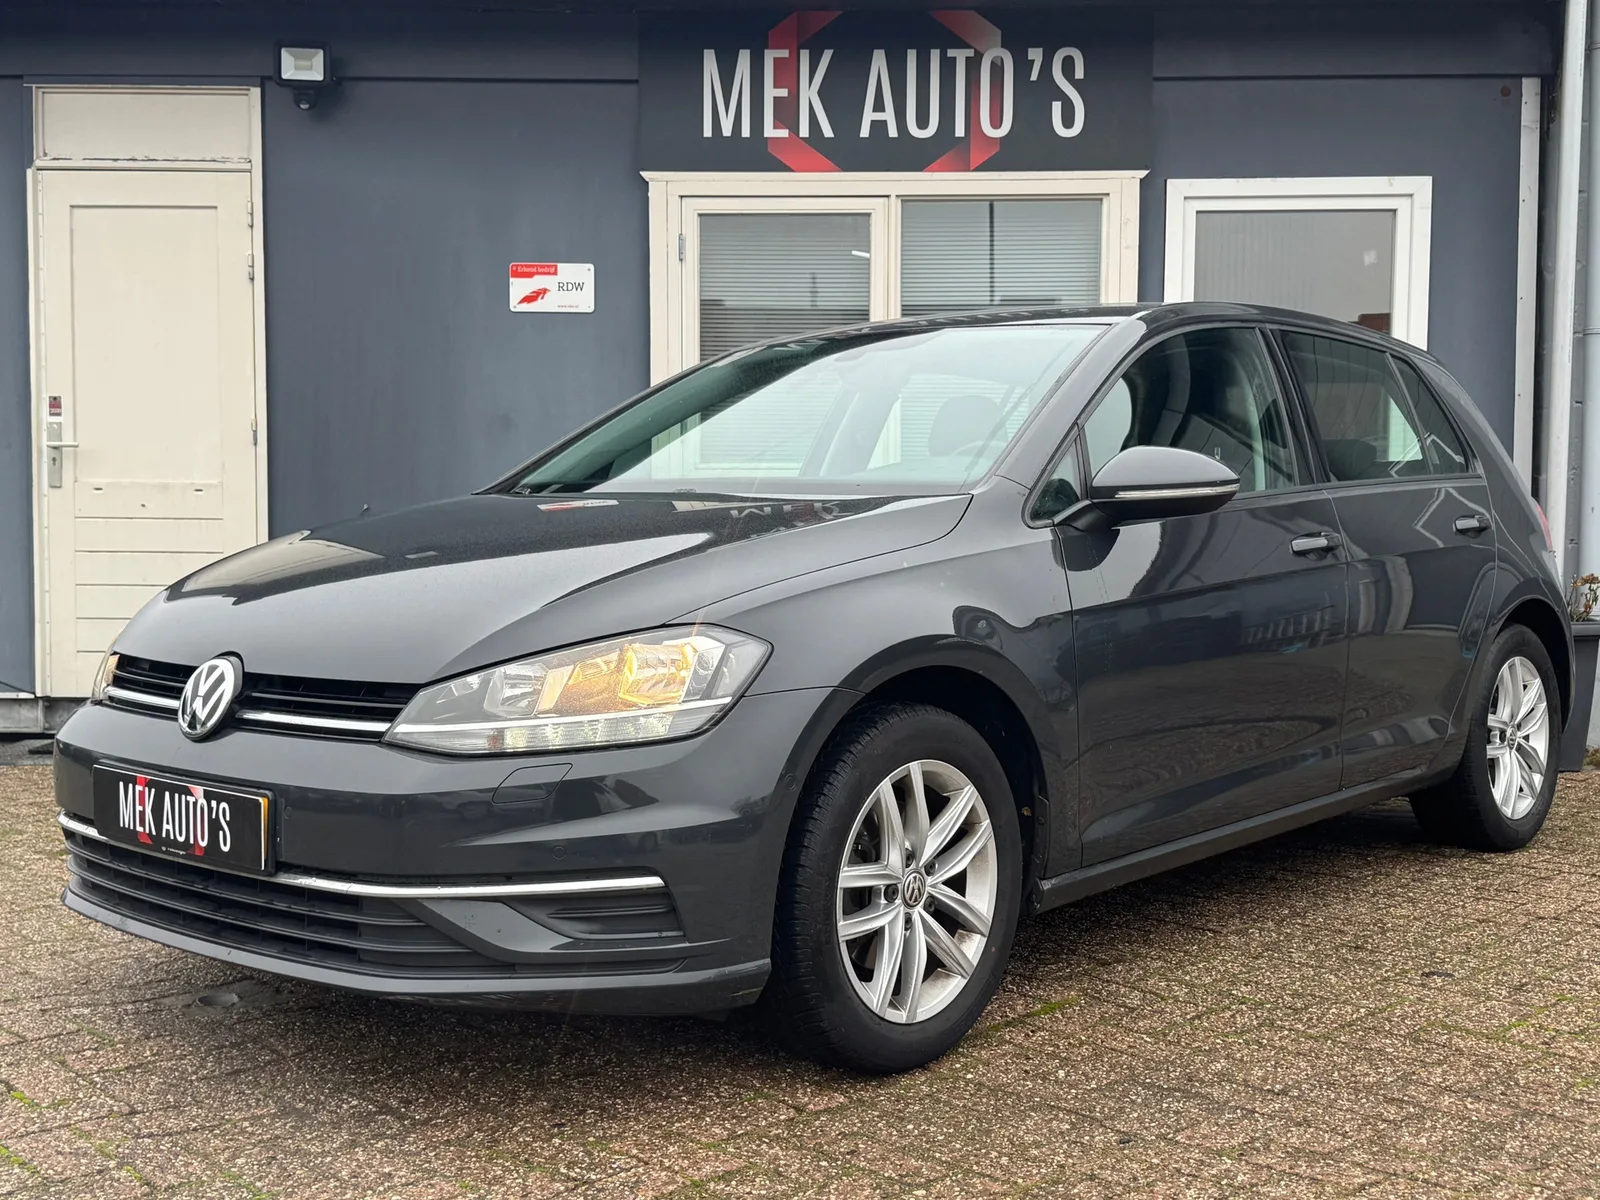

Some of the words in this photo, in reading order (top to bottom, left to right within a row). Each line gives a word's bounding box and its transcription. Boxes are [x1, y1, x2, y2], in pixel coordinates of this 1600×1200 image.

[702, 48, 835, 139] MEK
[859, 46, 1085, 139] AUTO'S
[538, 266, 556, 274] bedrijf
[557, 281, 585, 292] RDW
[118, 781, 157, 836] MEK
[161, 791, 231, 852] AUTO'S
